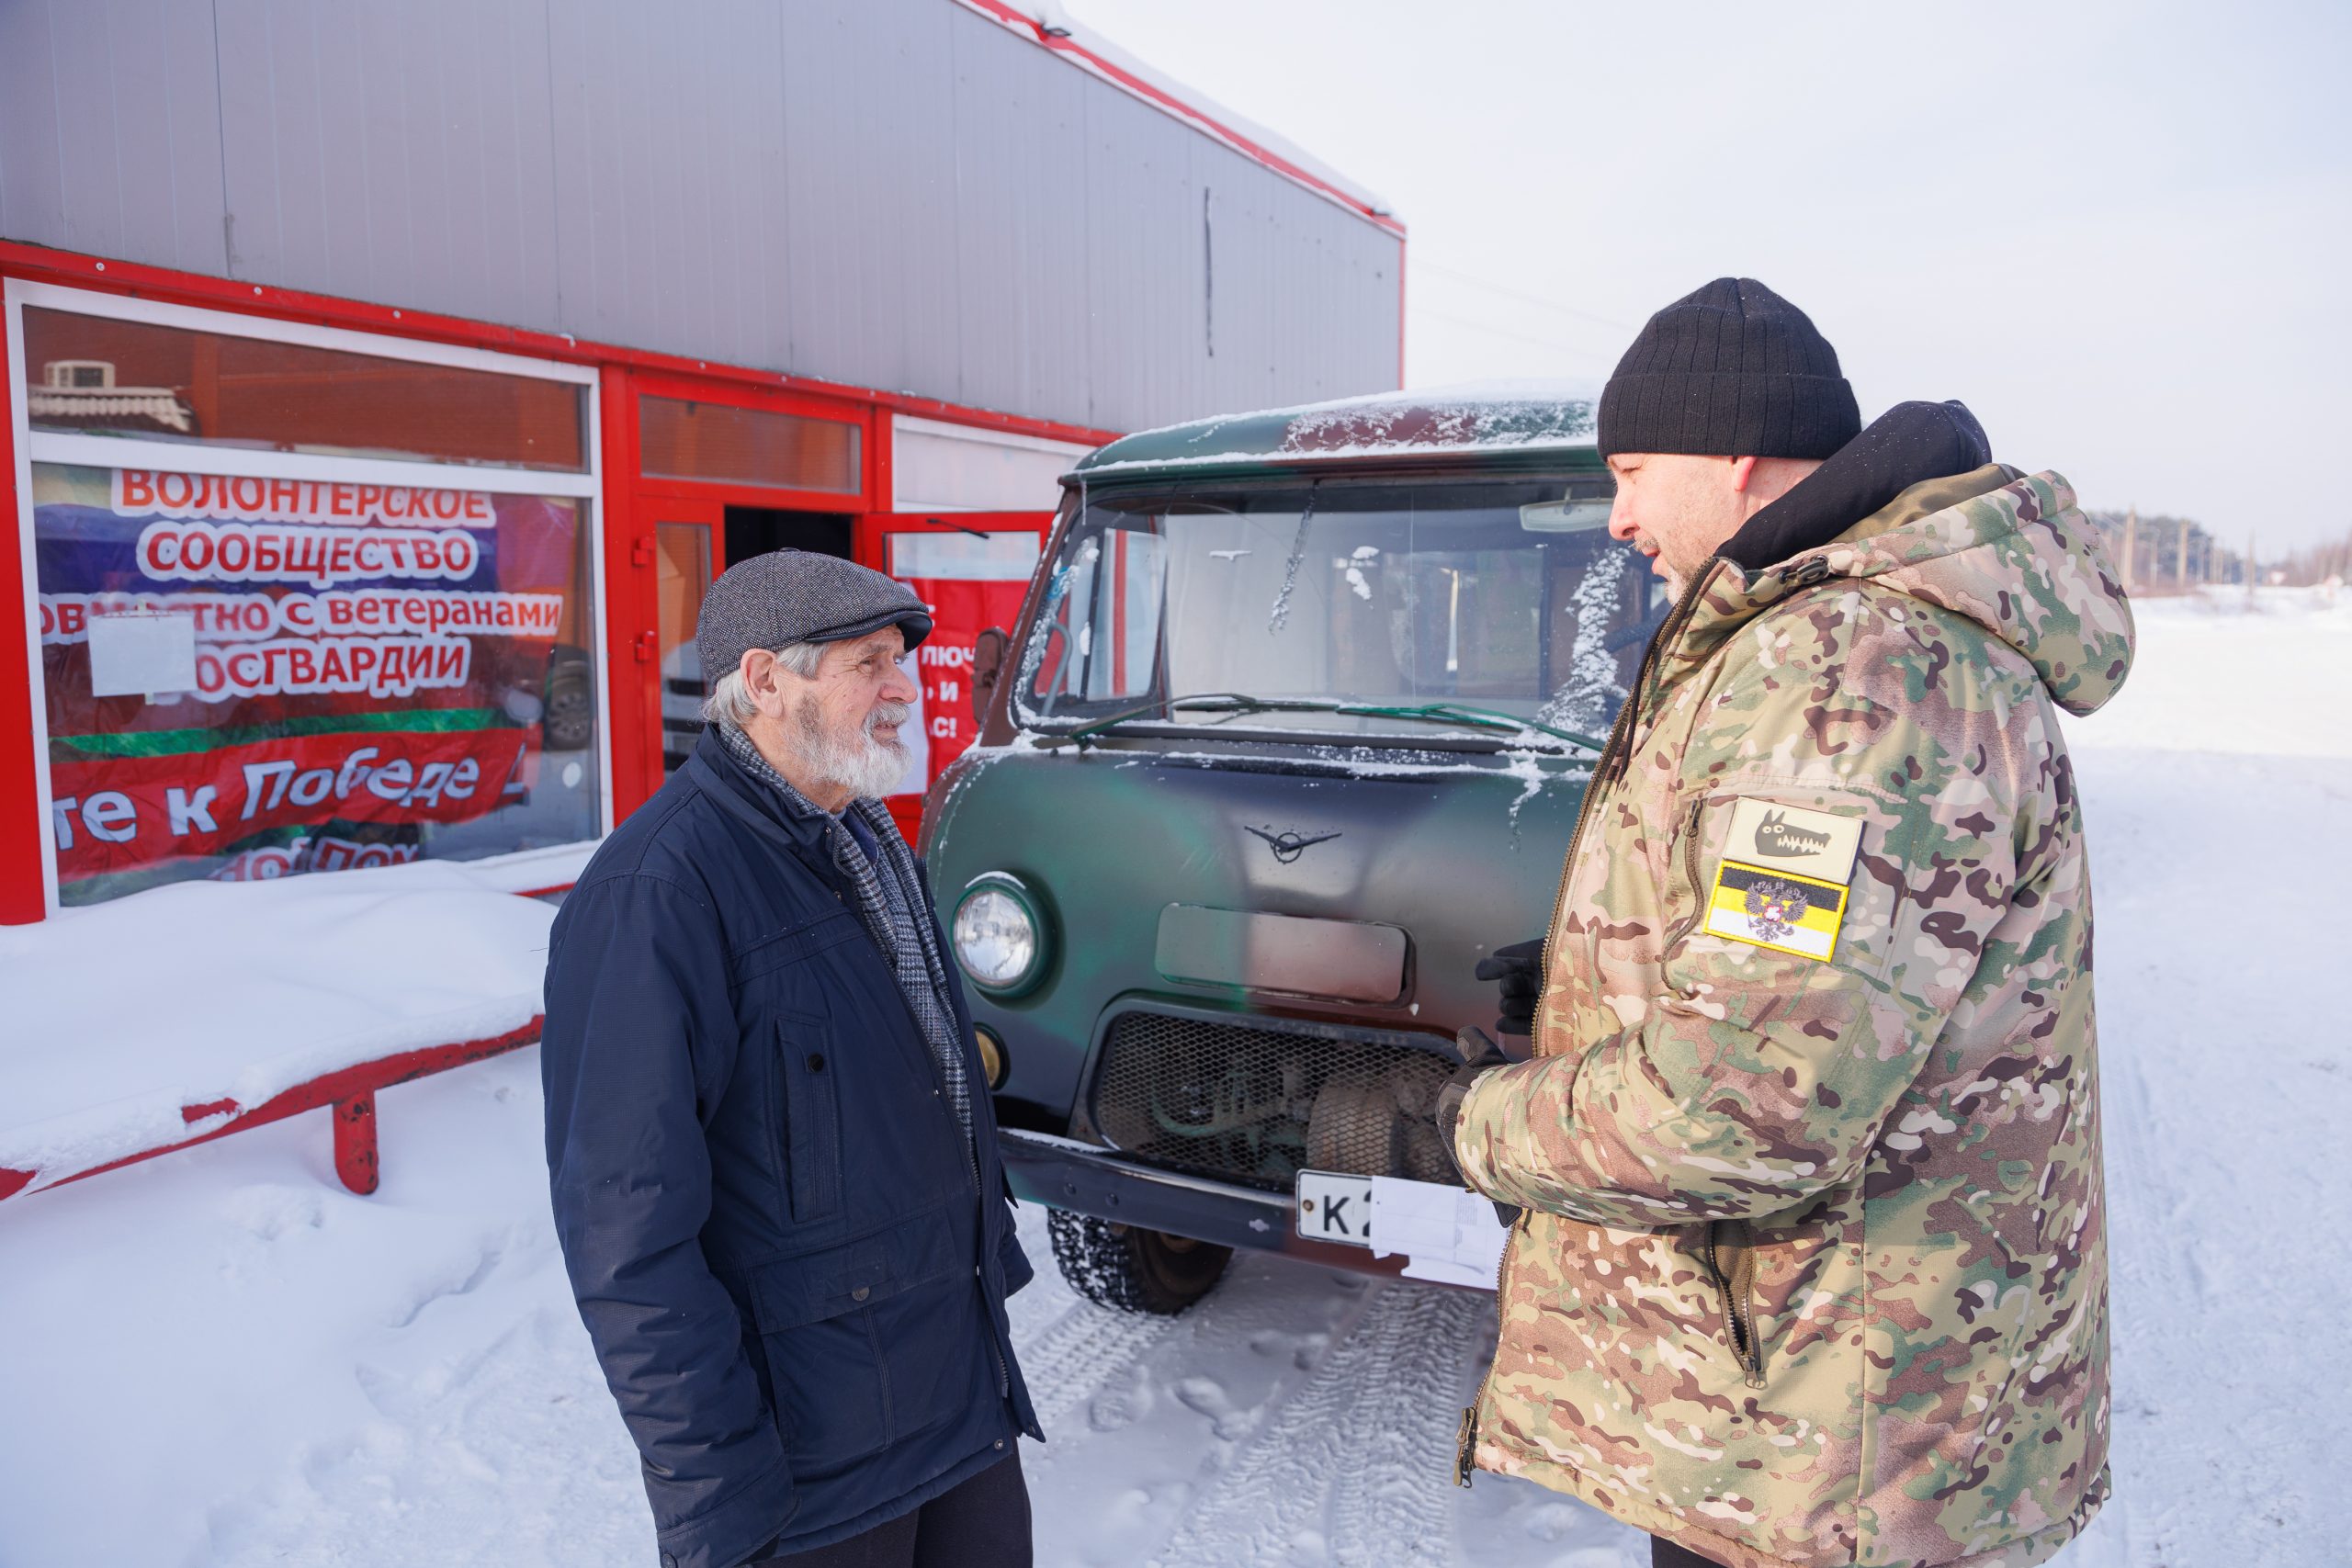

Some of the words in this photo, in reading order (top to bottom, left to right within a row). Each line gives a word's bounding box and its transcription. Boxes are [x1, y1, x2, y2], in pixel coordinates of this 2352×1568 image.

[122, 468, 489, 519] ВОЛОНТЕРСКОЕ
[146, 531, 471, 580] СООБЩЕСТВО
[328, 597, 560, 633] ветеранами
[197, 646, 465, 694] ОСГВАРДИИ
[240, 746, 481, 821] Победе
